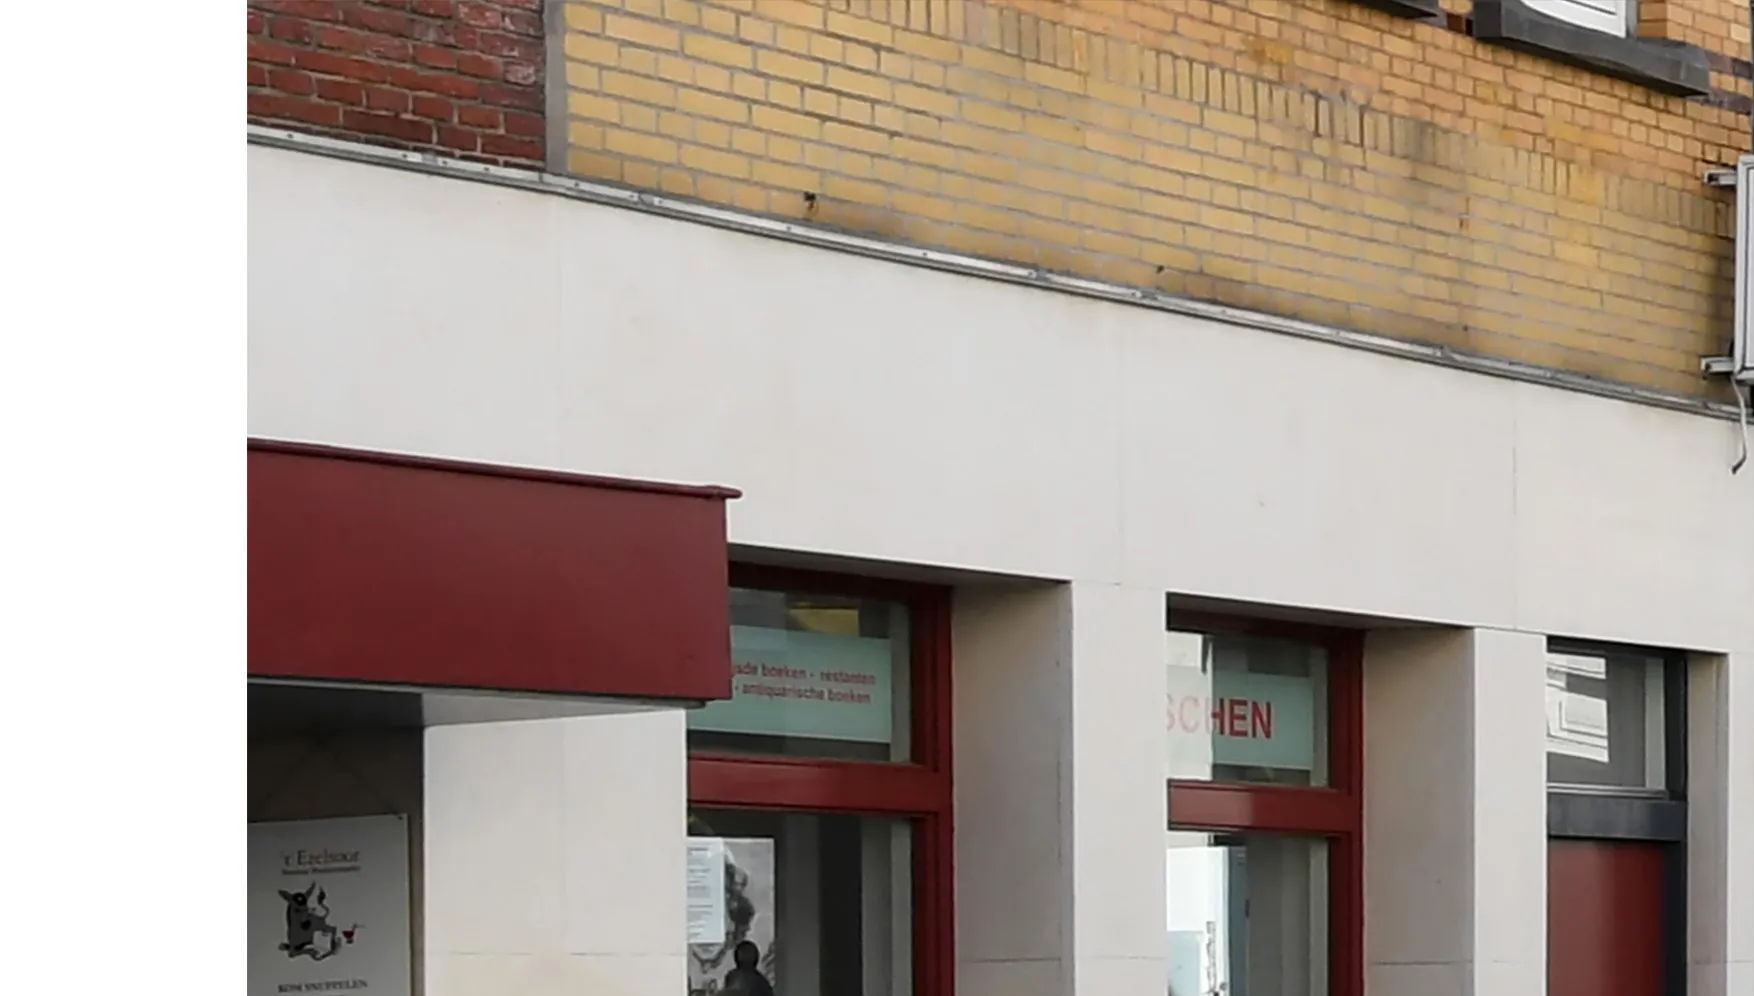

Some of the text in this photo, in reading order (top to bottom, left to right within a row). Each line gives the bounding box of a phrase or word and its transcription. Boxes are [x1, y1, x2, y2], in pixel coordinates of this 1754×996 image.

[762, 663, 807, 679] boeken
[820, 671, 876, 685] restanten
[828, 689, 870, 703] boeken
